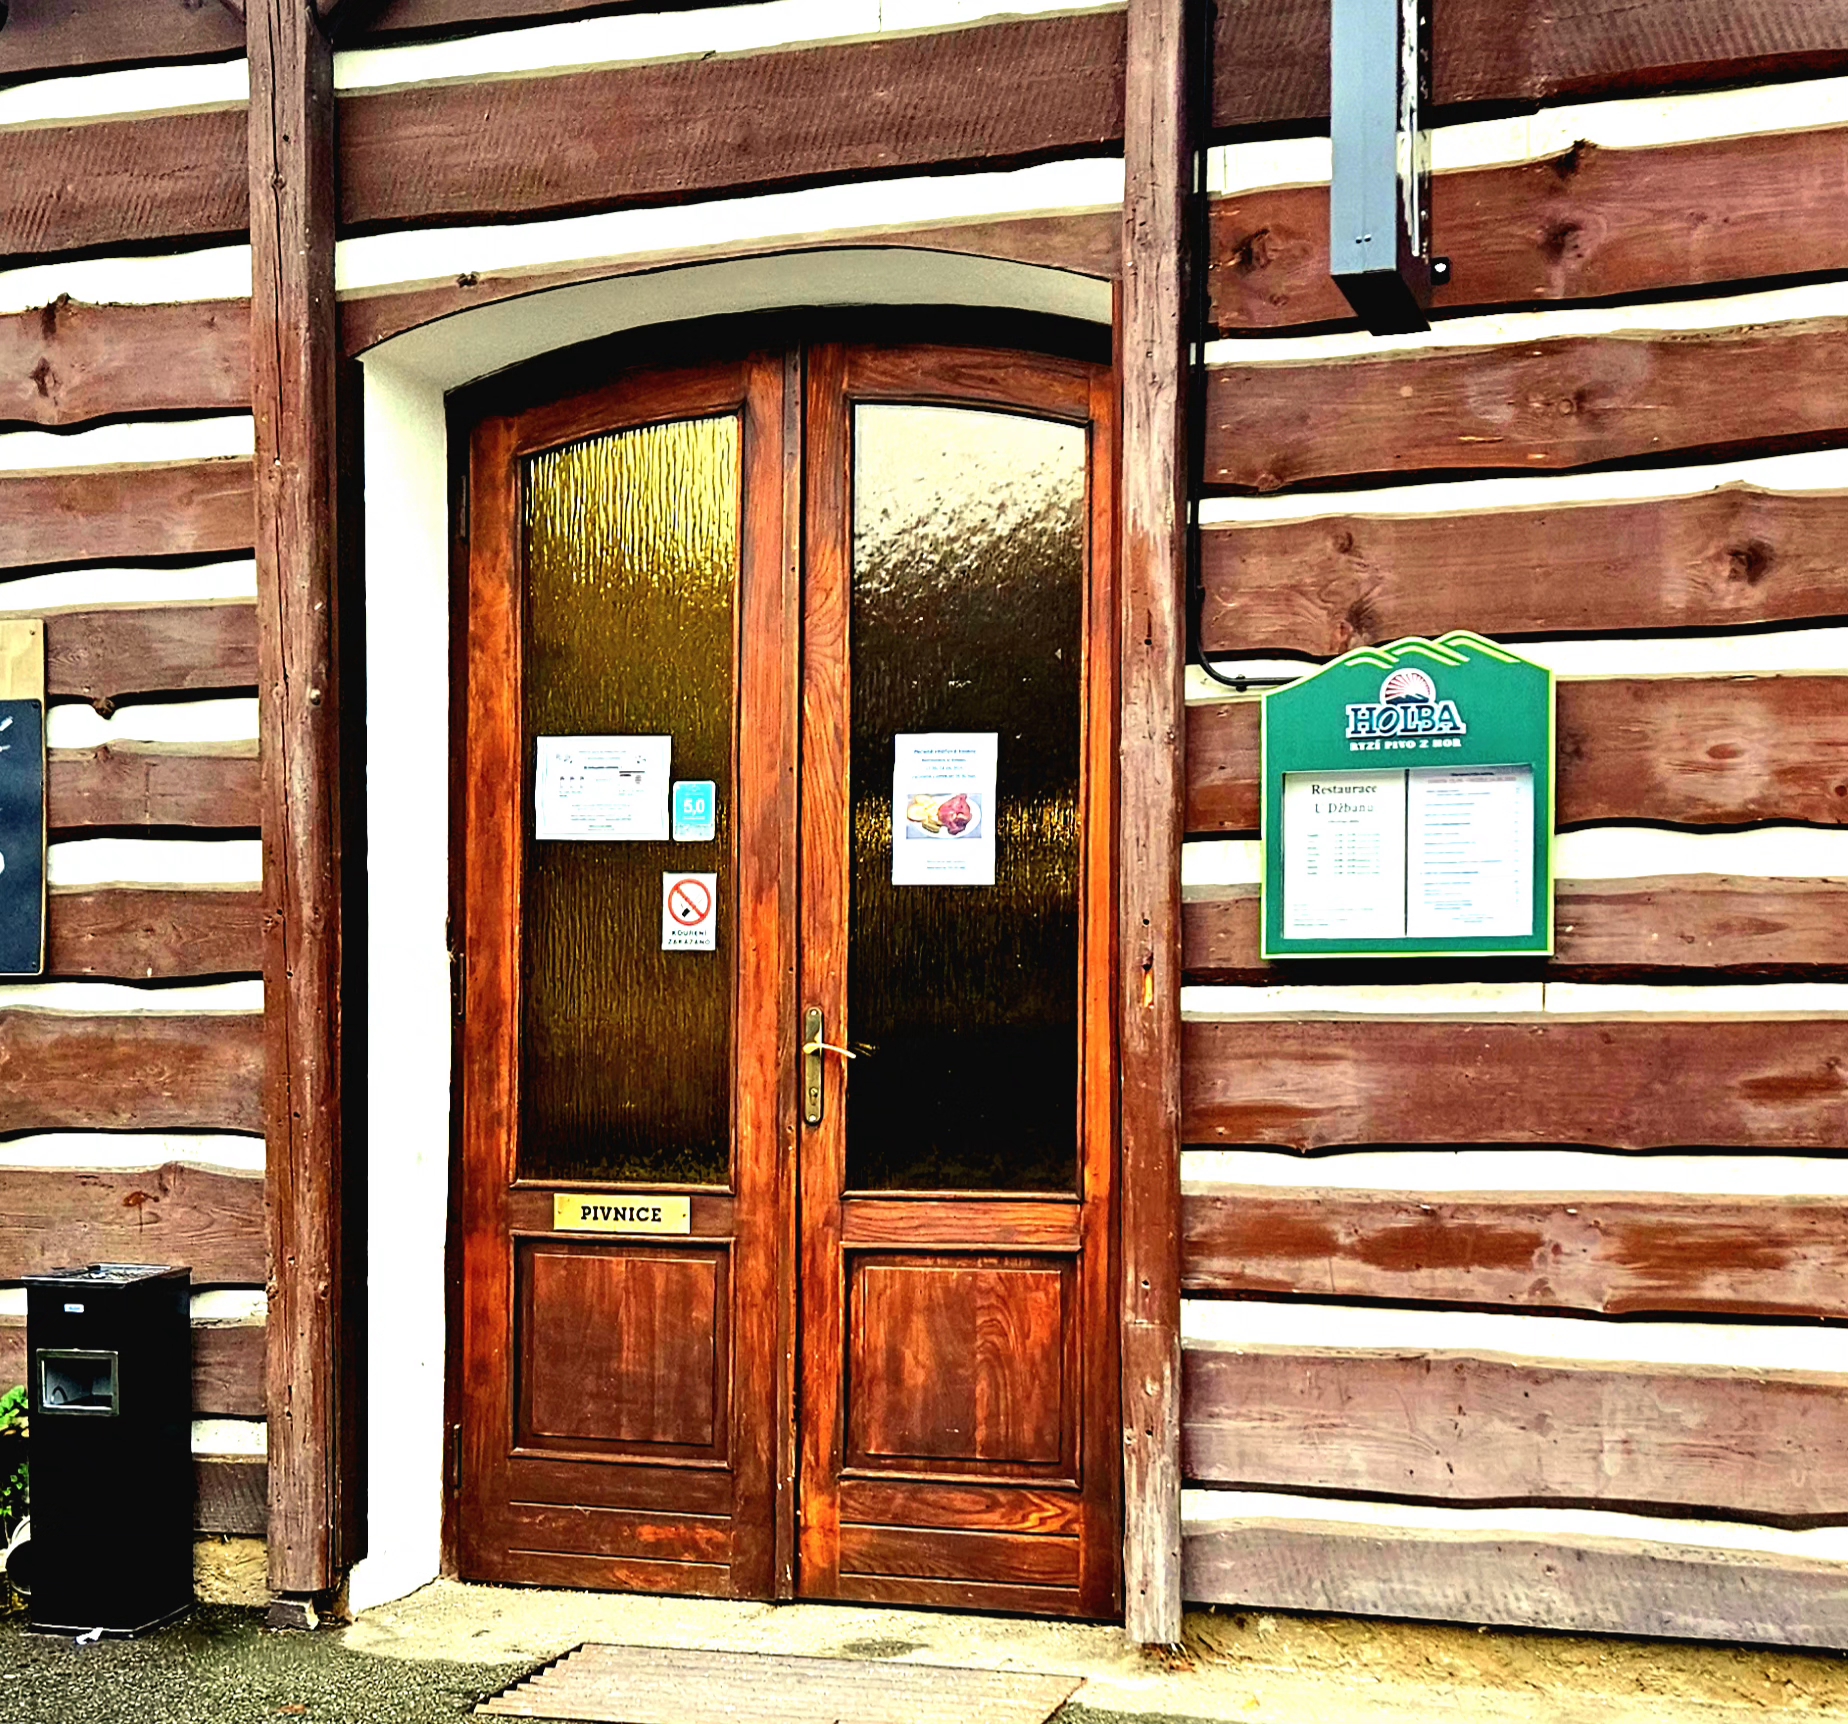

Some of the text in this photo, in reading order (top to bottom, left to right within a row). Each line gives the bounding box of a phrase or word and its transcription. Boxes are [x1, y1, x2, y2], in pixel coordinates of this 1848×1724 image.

[1346, 701, 1466, 737] HOLBA
[1311, 784, 1377, 795] Restaurace
[581, 1205, 662, 1222] PIVNICE
